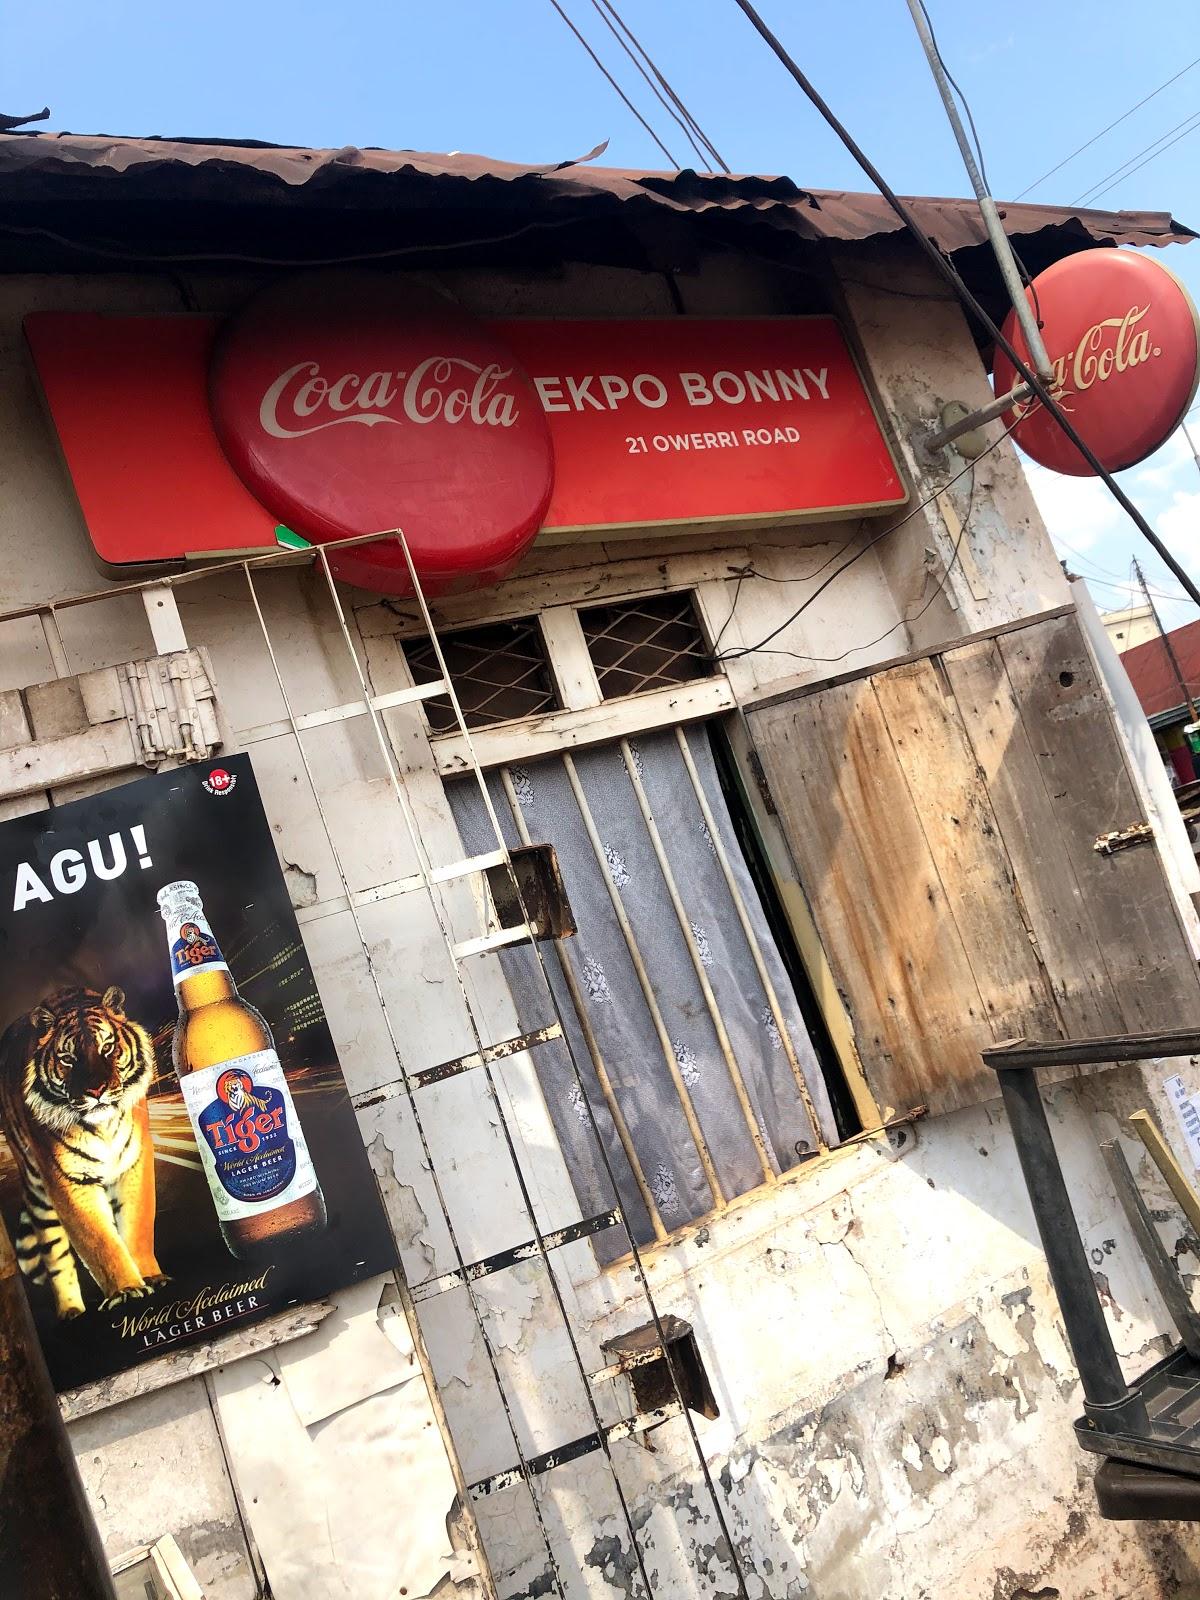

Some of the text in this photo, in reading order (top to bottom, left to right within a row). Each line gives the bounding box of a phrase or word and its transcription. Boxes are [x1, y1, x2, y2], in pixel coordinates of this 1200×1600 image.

[260, 356, 519, 438] Coca-Cola
[533, 368, 830, 412] EKPO BONNY
[625, 427, 800, 454] 21 OWERRI ROAD
[209, 774, 230, 787] 18+
[13, 824, 153, 912] AGU!
[175, 941, 217, 965] Tiger
[206, 1106, 285, 1154] Tiger
[218, 1146, 238, 1156] SINCE
[231, 1155, 283, 1177] LAGER BEER
[111, 1265, 276, 1339] World Acclaimed
[143, 1296, 259, 1347] LAGER BEER
